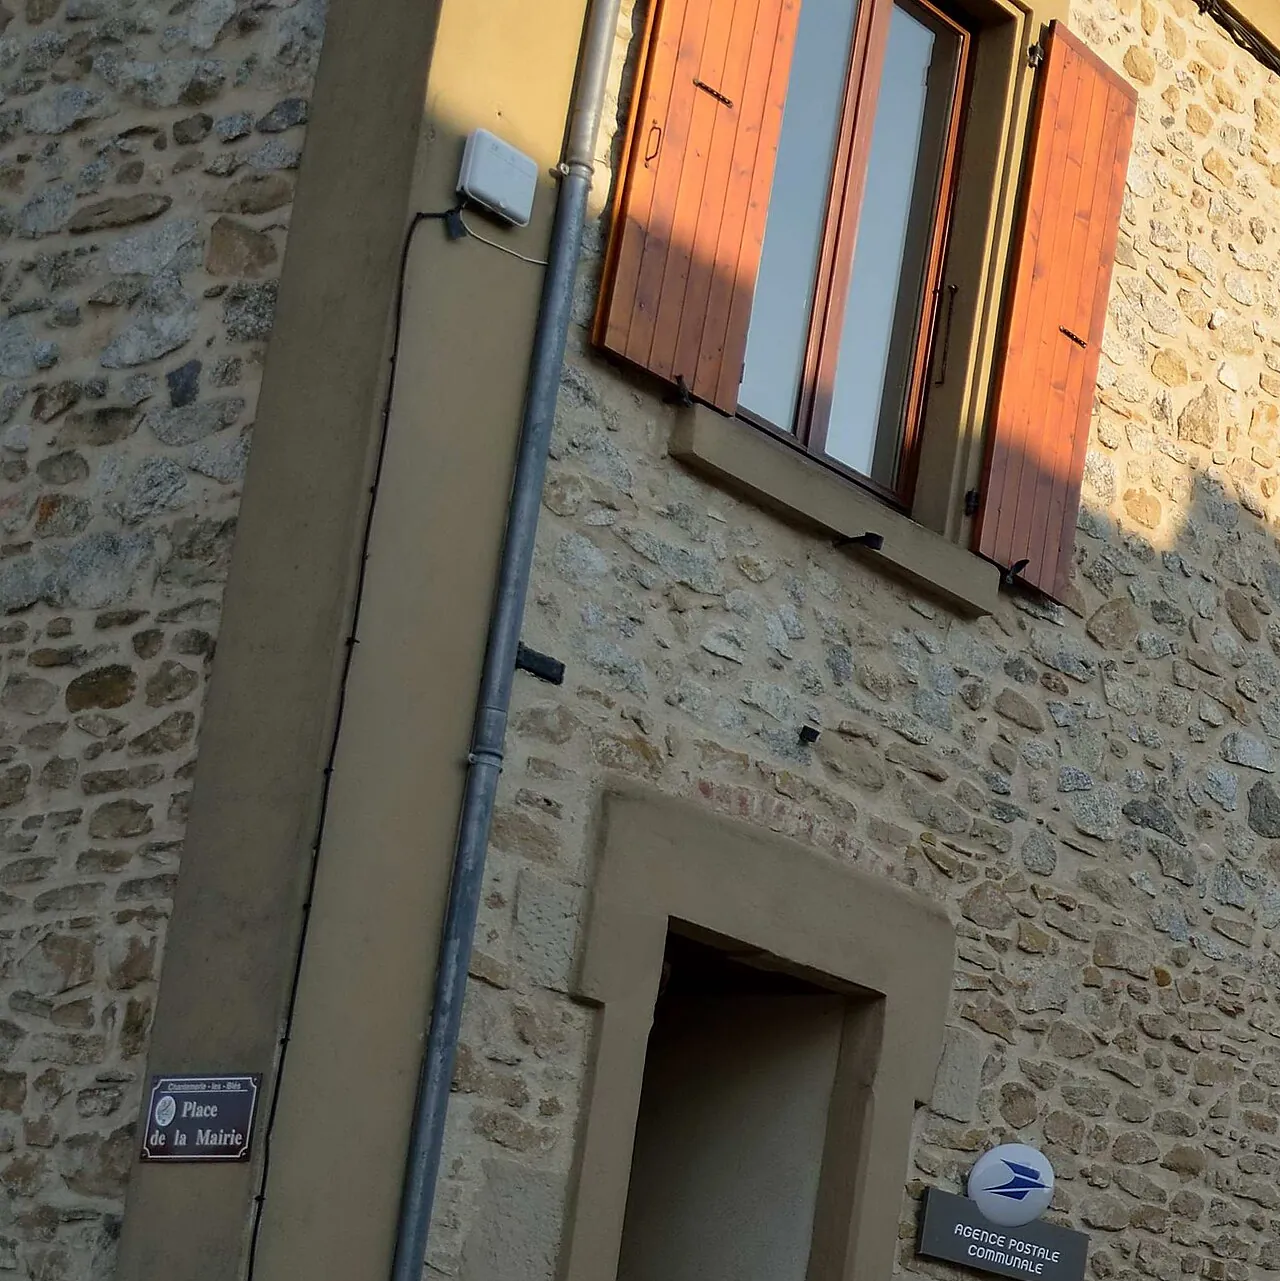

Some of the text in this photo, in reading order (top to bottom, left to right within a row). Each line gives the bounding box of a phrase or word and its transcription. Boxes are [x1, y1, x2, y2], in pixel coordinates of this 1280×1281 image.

[181, 1101, 218, 1118] Place
[150, 1128, 243, 1146] de la Mairie
[954, 1223, 1061, 1263] AGENCE POSTALE
[968, 1244, 1044, 1275] COMMUNALE
